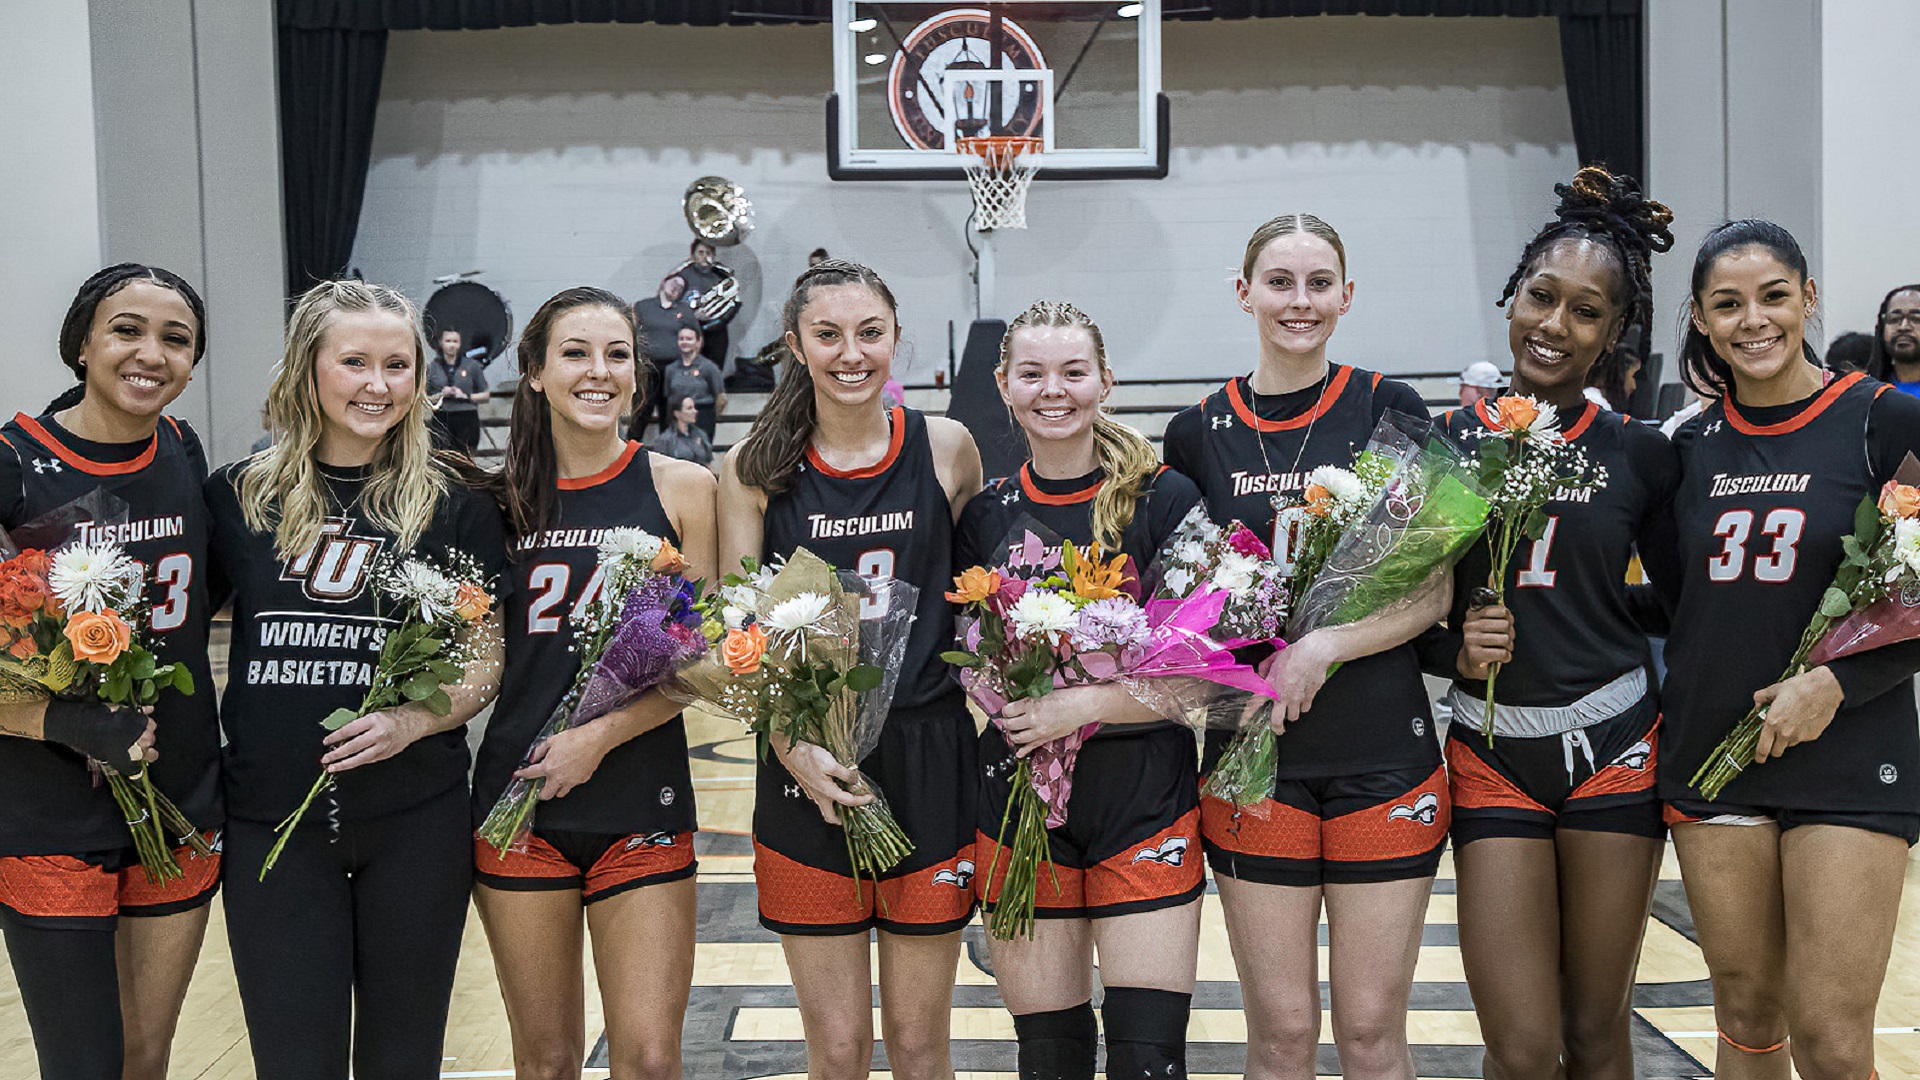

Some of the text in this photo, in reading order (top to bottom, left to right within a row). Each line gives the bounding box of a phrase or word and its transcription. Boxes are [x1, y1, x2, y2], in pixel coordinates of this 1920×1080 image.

[1709, 472, 1811, 498] TUSCULUM
[74, 515, 183, 547] TUSCULUM
[807, 510, 914, 539] TUSCULUM
[1516, 514, 1559, 588] 1
[1706, 507, 1807, 584] 33
[855, 547, 895, 621] 3
[259, 621, 388, 652] WOMEN'S
[247, 659, 390, 687] BASKETBA
